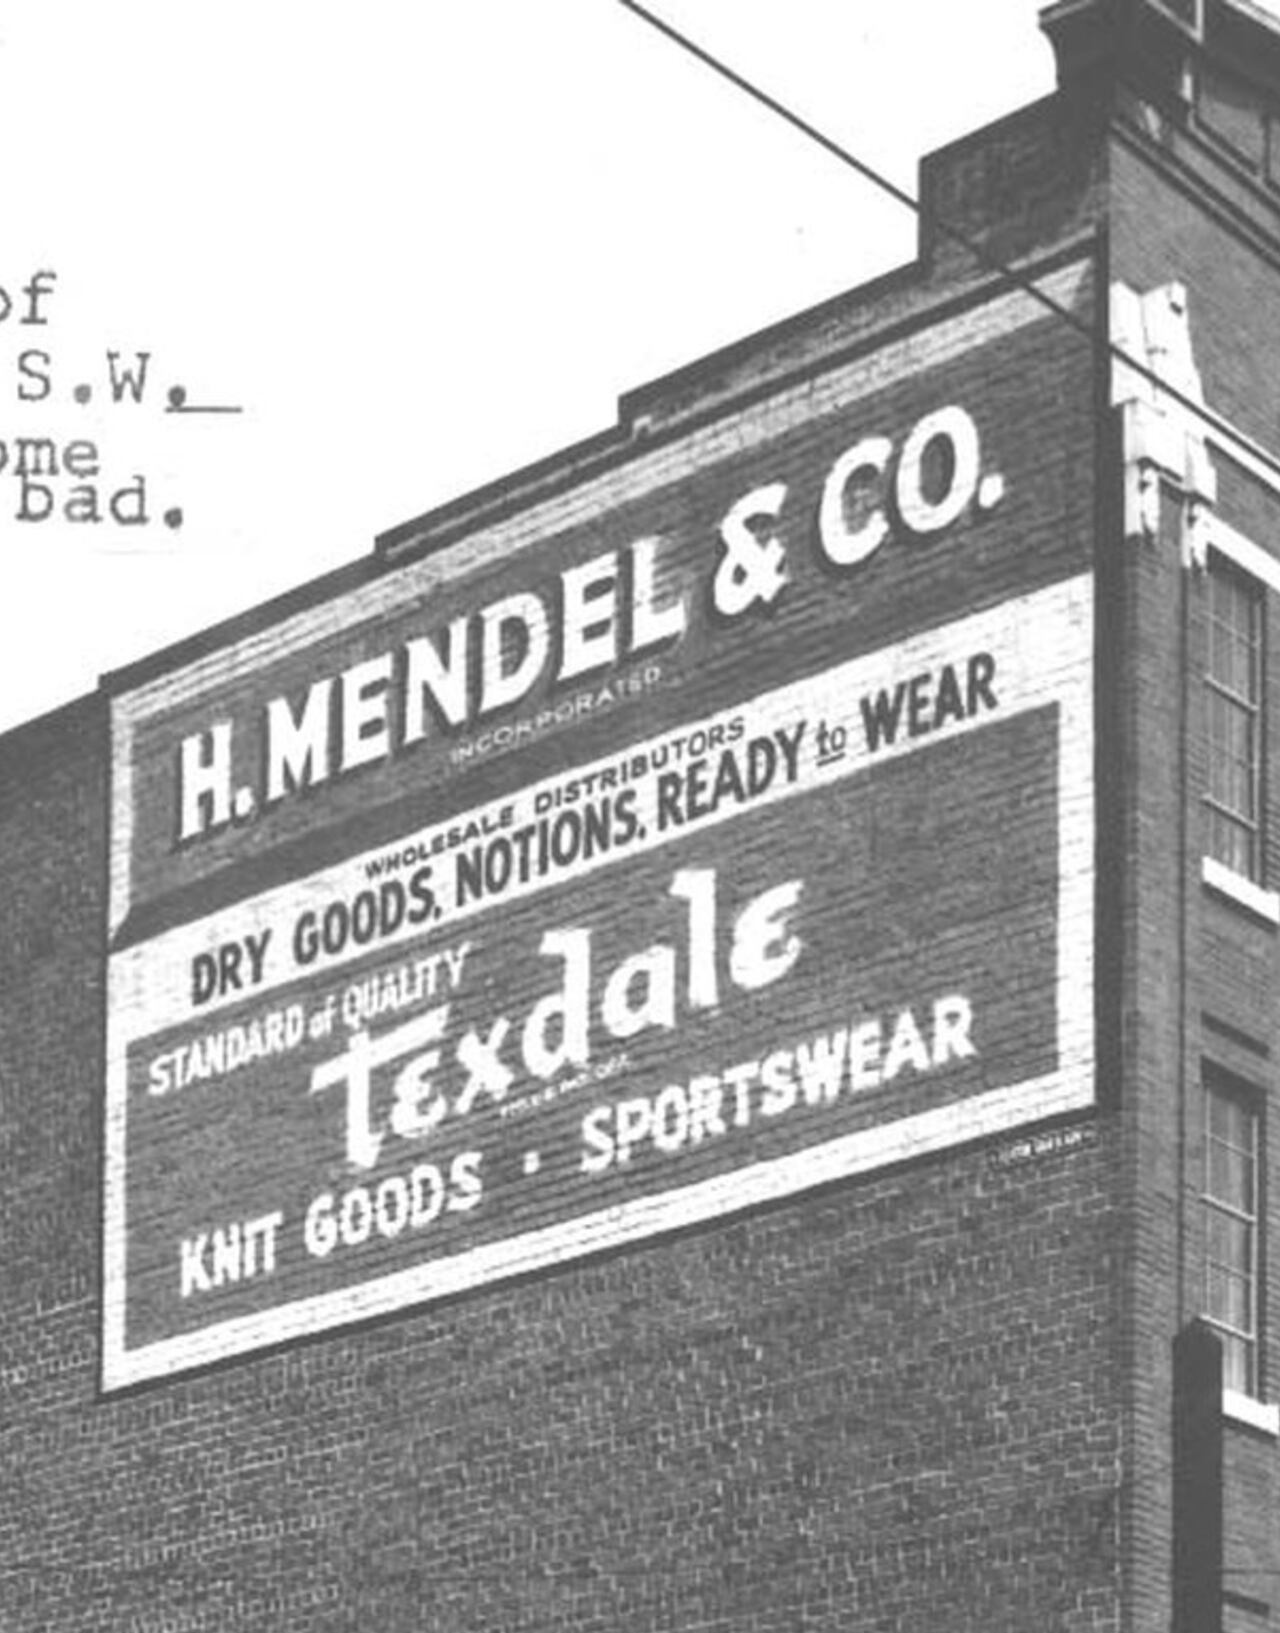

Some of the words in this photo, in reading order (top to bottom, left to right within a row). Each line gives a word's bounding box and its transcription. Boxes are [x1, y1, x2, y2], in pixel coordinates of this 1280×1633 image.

[714, 483, 787, 616] &
[818, 406, 1004, 565] CO.
[364, 807, 515, 882] WHOLESALE
[533, 717, 745, 815] DISTRIBUTORS
[450, 665, 662, 766] INCORPORATED
[190, 931, 271, 1005] DRY
[657, 721, 805, 831] READY
[815, 718, 846, 764] to
[860, 652, 998, 746] WEAR
[147, 1008, 302, 1096] STANDARD
[307, 992, 336, 1039] of
[342, 942, 472, 1023] QUALITY
[310, 869, 803, 1168] Texdale
[179, 1214, 281, 1298] KNIT
[303, 1151, 482, 1257] GOODS
[580, 995, 976, 1173] SPORTSWEAR
